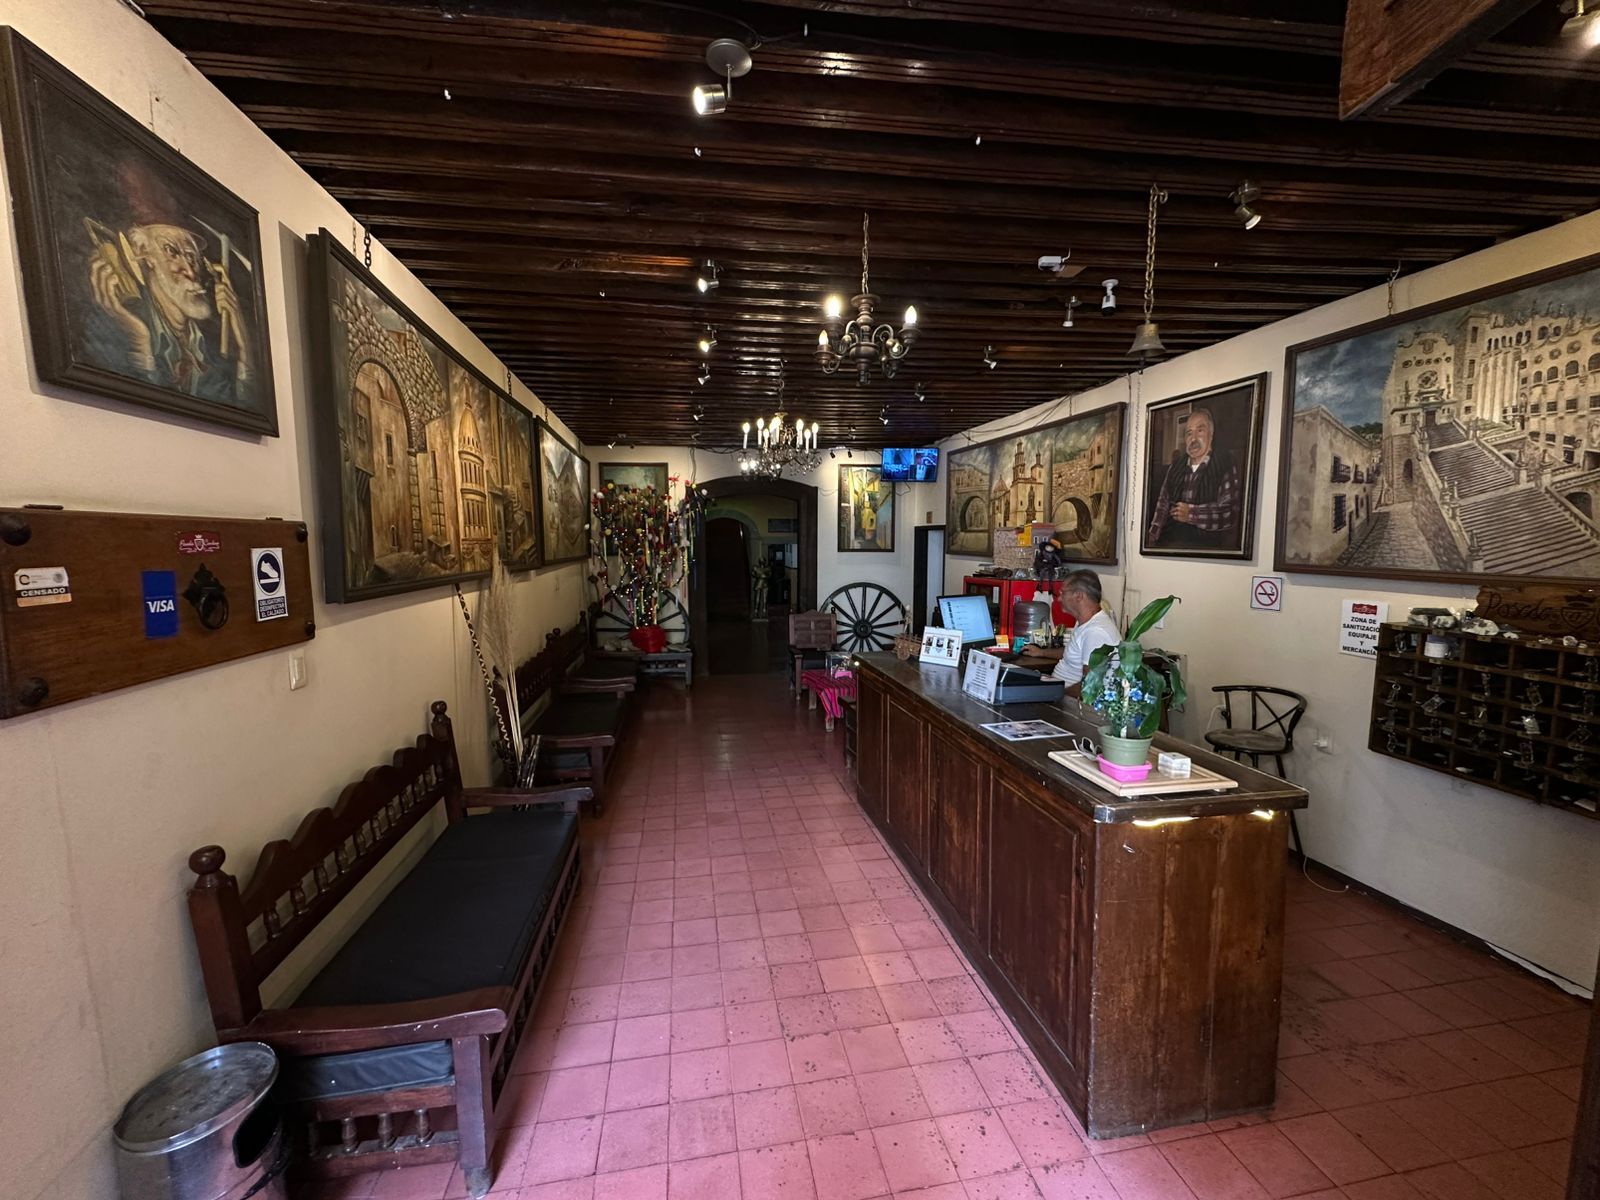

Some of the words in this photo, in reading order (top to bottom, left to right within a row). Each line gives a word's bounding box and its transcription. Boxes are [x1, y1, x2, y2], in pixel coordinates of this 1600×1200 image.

[20, 587, 66, 597] CENSADO
[145, 599, 175, 613] VISA
[1342, 623, 1380, 633] SANITIZACIÓ
[1348, 631, 1377, 640] EQUIPAJE
